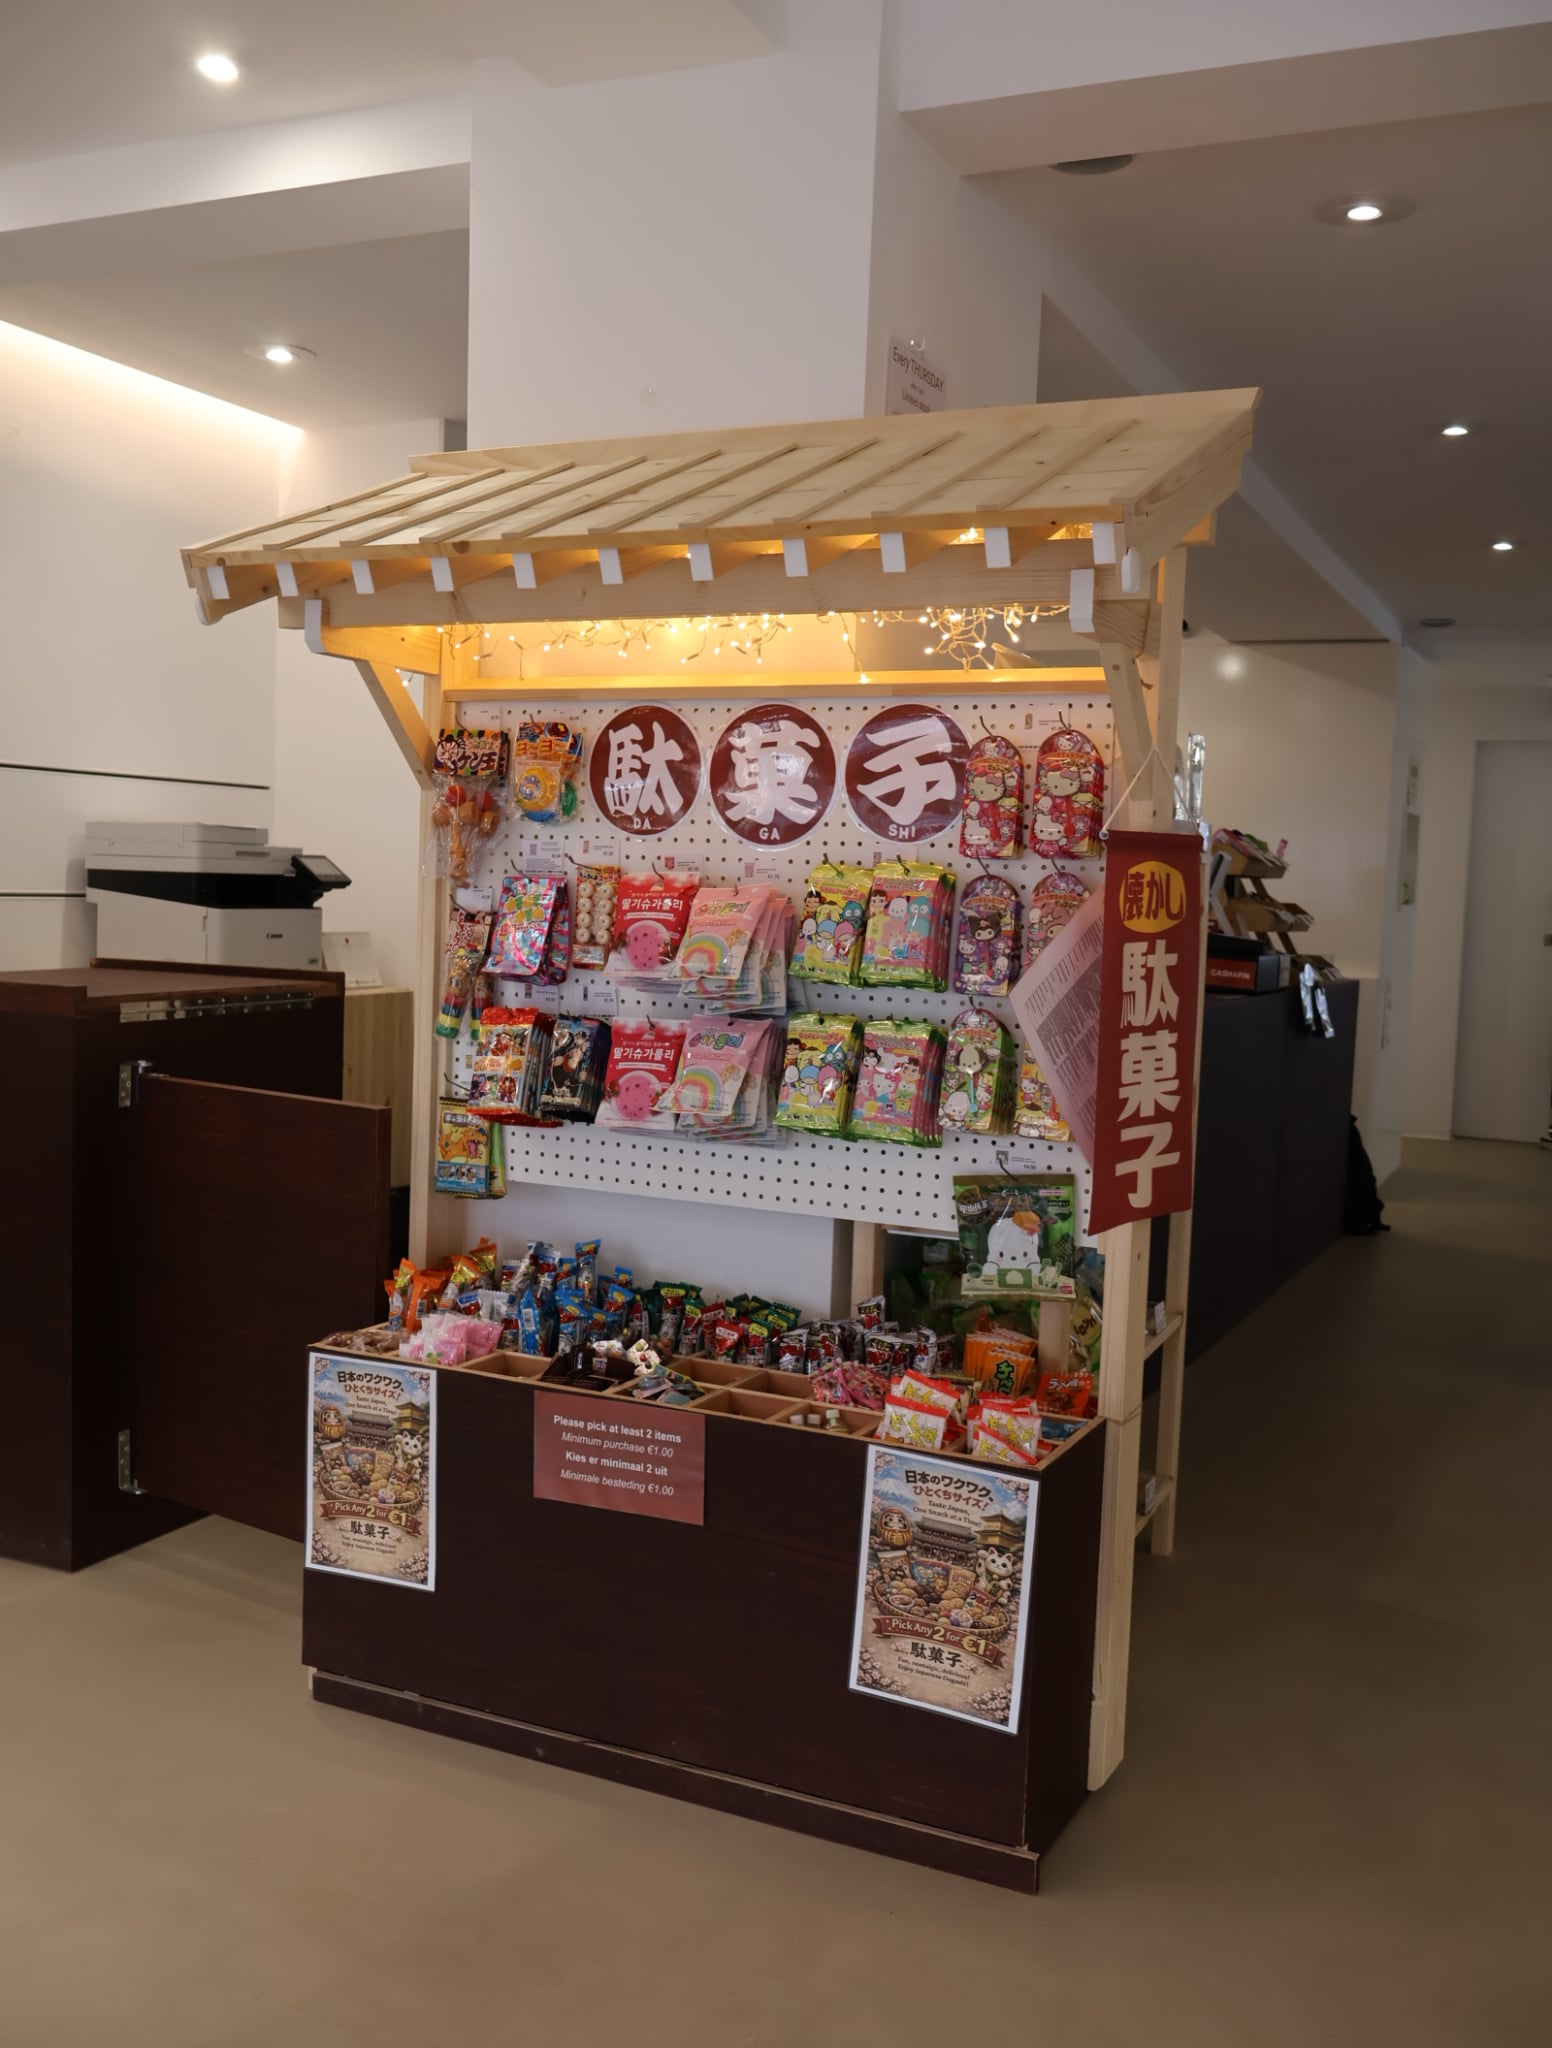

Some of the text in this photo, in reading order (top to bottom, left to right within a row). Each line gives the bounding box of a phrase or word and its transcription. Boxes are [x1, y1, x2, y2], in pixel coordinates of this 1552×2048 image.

[892, 346, 910, 374] Every
[911, 358, 945, 393] THURSDAY
[604, 720, 684, 817] 駄
[724, 719, 821, 825] 菓
[857, 716, 957, 826] 子
[633, 817, 652, 830] DA
[758, 827, 781, 841] GA
[888, 823, 916, 839] SHI
[1115, 939, 1182, 1209] 駄菓子
[337, 1370, 405, 1393] 日本のワクワク、
[553, 1414, 682, 1443] Please pick at least 2 items
[561, 1431, 674, 1458] Minimum purchase €1.00
[565, 1450, 668, 1477] Kies er minimaal 2 uit
[560, 1469, 675, 1496] Minimale besteding €1.00
[905, 1470, 994, 1502] 日本のワクワク、
[334, 1502, 407, 1526] Pick Any 2 for €1
[913, 1506, 927, 1514] One
[928, 1509, 949, 1519] Snack
[928, 1500, 970, 1516] Taste Japan,
[350, 1520, 390, 1539] 駄菓子
[891, 1618, 986, 1656] Pick Any 2 for €1
[910, 1641, 962, 1668] 駄菓子
